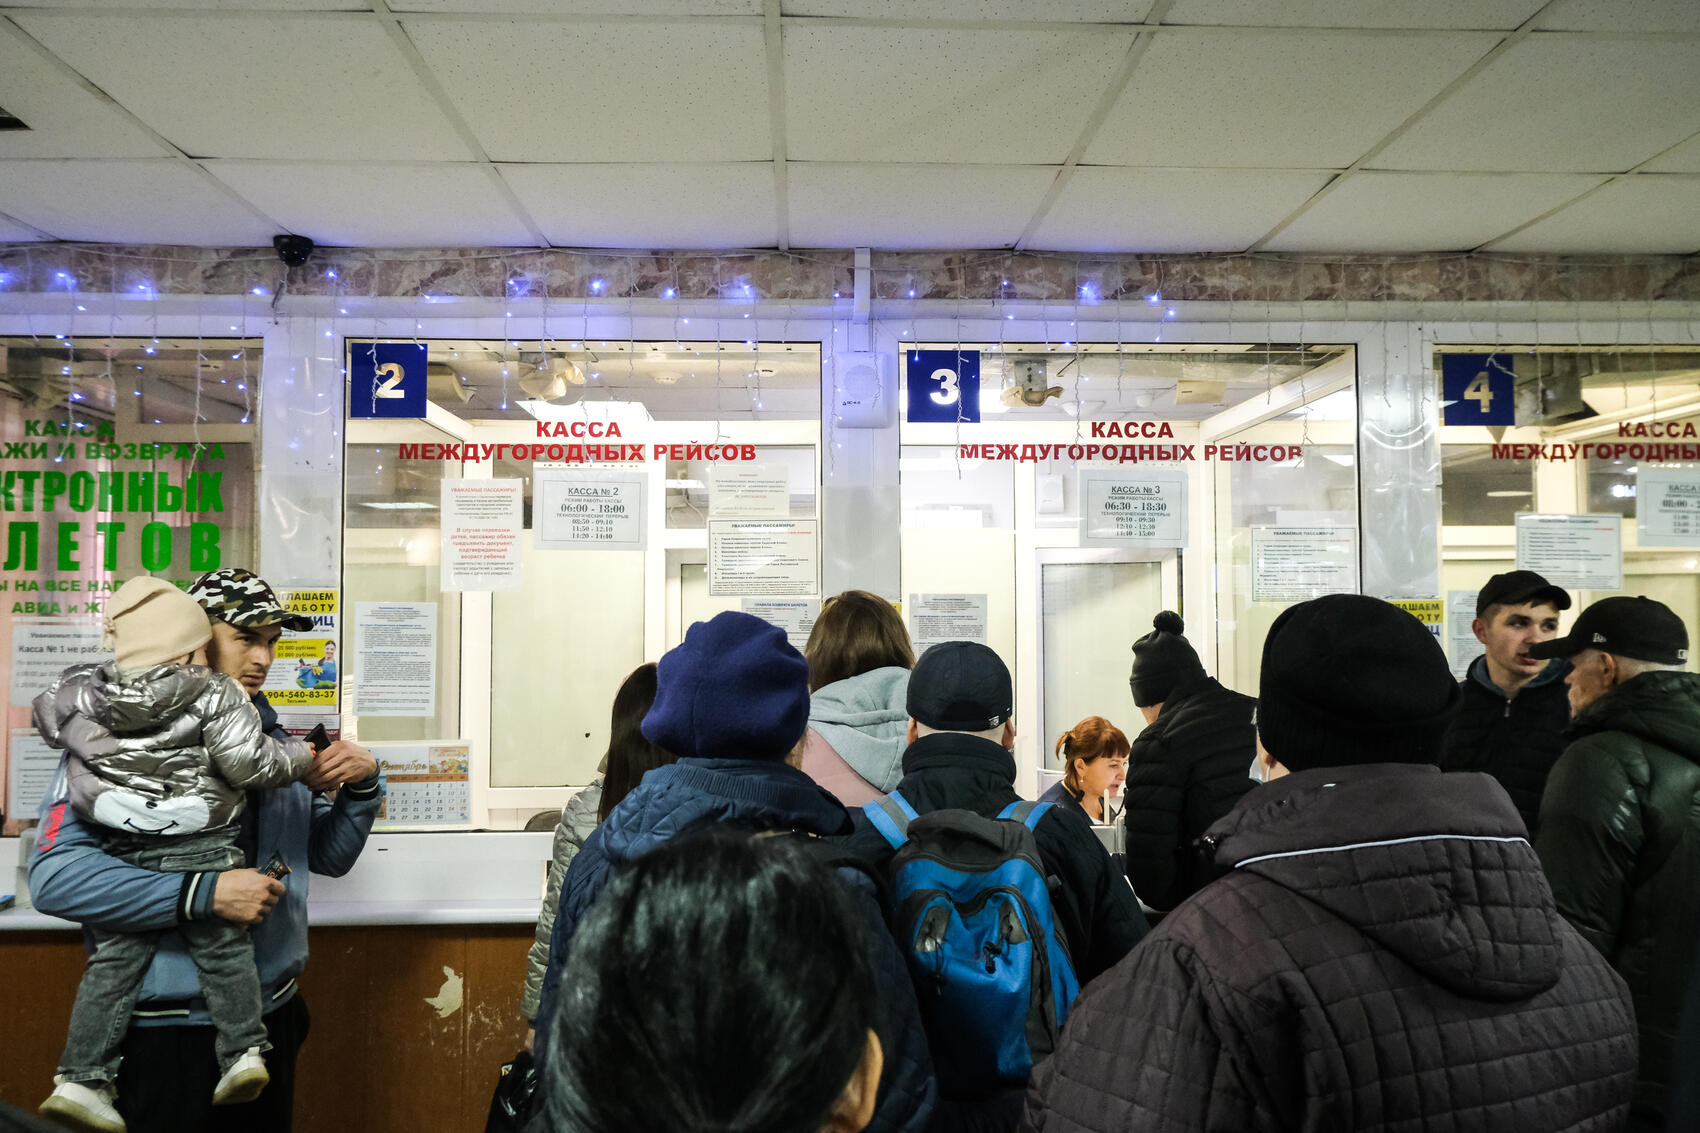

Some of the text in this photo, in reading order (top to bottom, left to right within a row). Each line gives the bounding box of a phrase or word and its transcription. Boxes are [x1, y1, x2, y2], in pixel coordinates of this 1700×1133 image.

[376, 363, 405, 398] 2
[930, 368, 959, 405] 3
[1464, 372, 1494, 413] 4
[25, 420, 115, 437] КАССА
[536, 421, 622, 437] КАССА
[1091, 422, 1173, 438] КАССА
[1618, 422, 1697, 438] КАССА
[0, 442, 226, 460] ЖИ И ВОЗВРАТА
[399, 441, 756, 464] МЕЖДУГОРОДНЫХ РЕЙСОВ
[960, 442, 1302, 464] МЕЖДУГОРОДНЫХ РЕЙСОВ
[1492, 444, 1700, 462] МЕЖДУГОРОДНЫ
[613, 487, 619, 495] 2
[1155, 486, 1160, 494] 3
[561, 504, 588, 512] 06:00
[599, 504, 625, 513] 18:00
[1105, 502, 1131, 510] 06:30
[1142, 502, 1167, 511] 18:30
[15, 580, 39, 591] НА
[46, 580, 80, 591] ВСЕ
[12, 602, 61, 613] АВИА
[285, 604, 334, 612] РАБОТУ
[310, 616, 334, 628] ИЦ
[18, 645, 44, 653] Касса
[46, 645, 57, 653] №
[60, 645, 64, 653] 1
